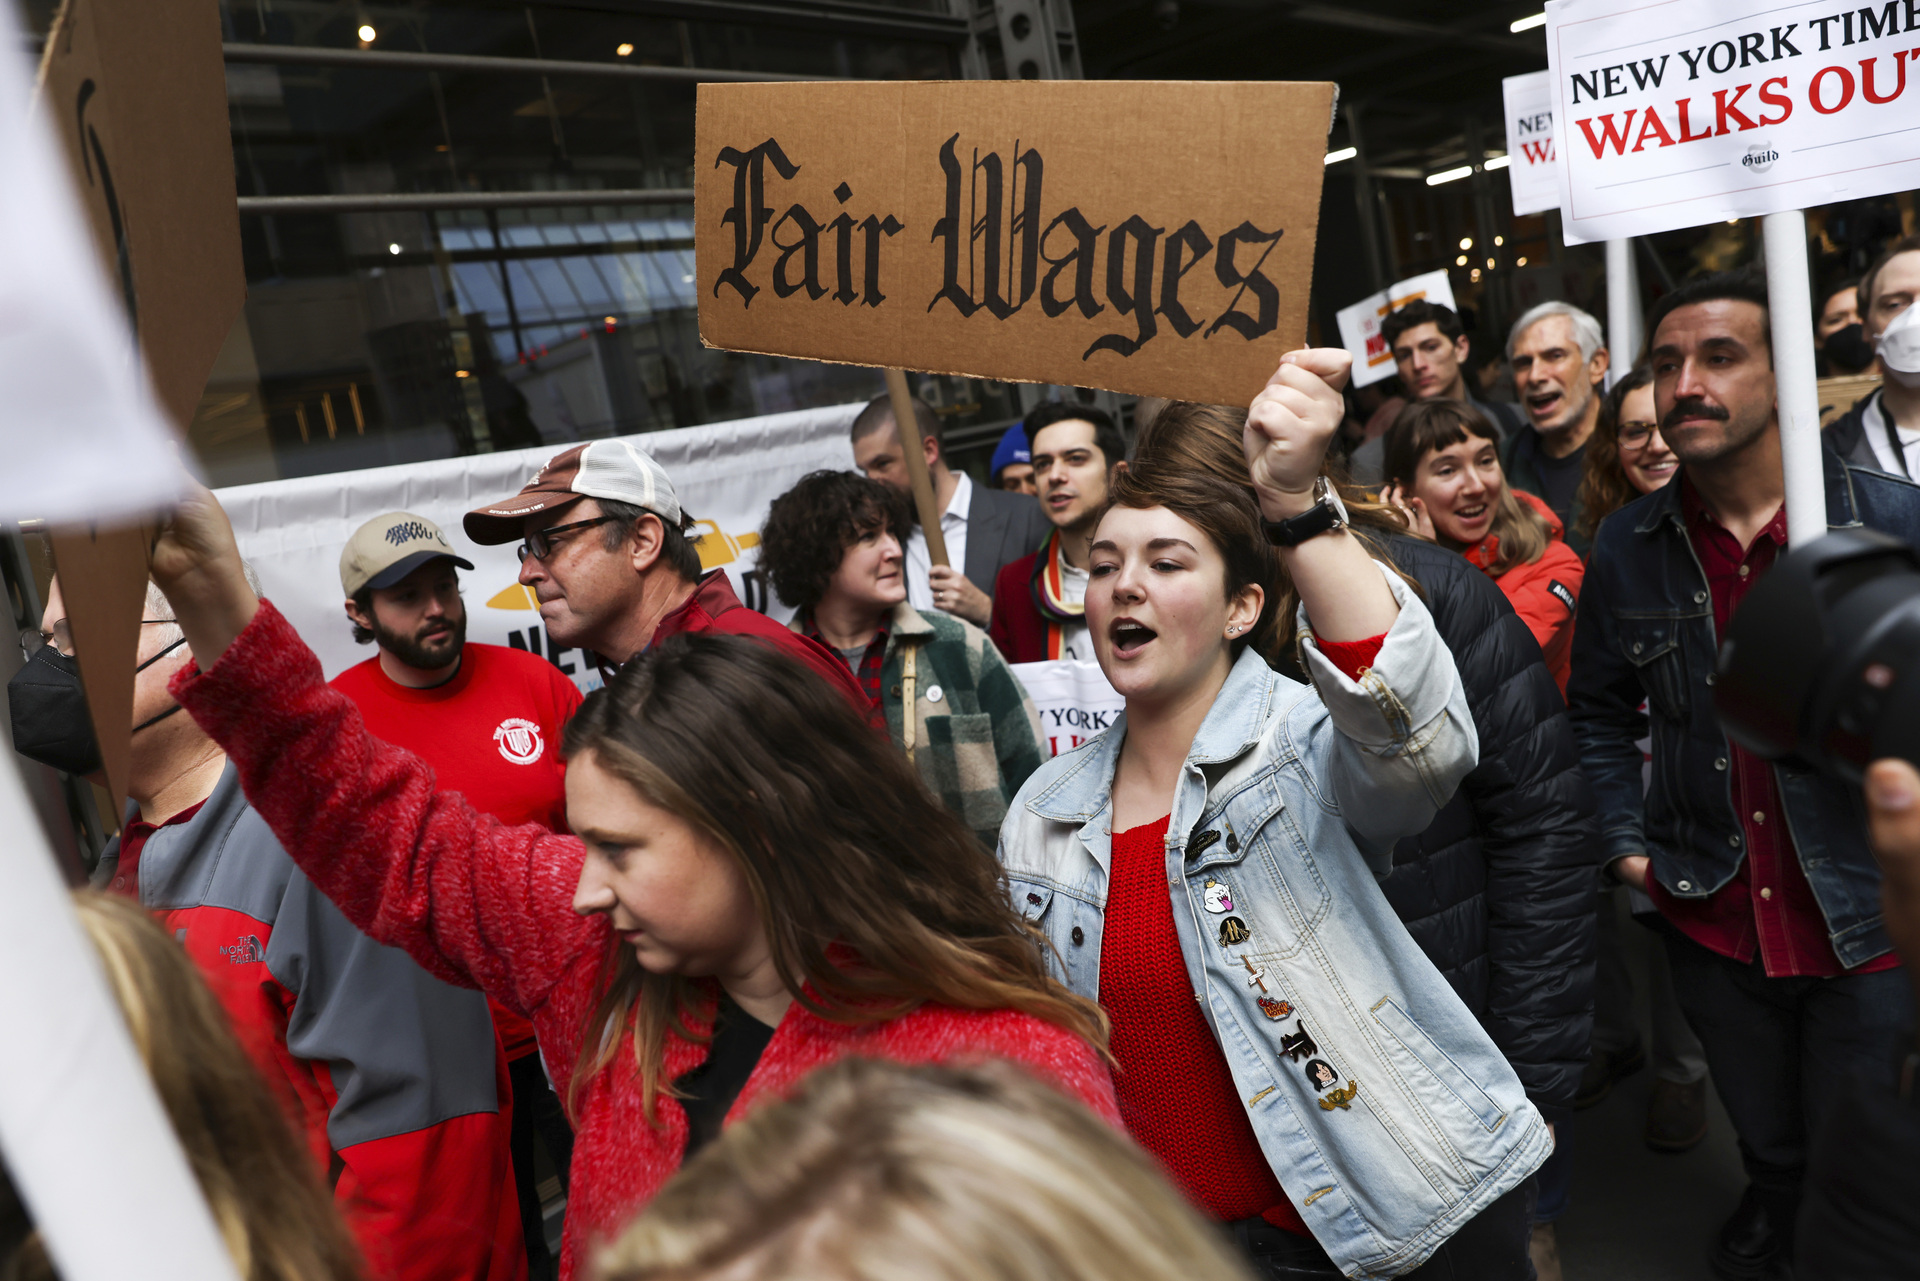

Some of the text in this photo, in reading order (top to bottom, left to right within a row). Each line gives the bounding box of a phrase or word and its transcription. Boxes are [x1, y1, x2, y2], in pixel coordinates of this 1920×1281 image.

[1570, 54, 1671, 104] NEW
[1678, 23, 1803, 81] YORK
[1575, 47, 1920, 160] WALKS OU
[1517, 110, 1553, 135] NE
[1741, 150, 1779, 167] Guild
[713, 132, 1284, 361] Fair Wages
[1050, 707, 1111, 730] YORK
[219, 945, 251, 955] NORTH
[237, 935, 251, 947] THE
[230, 953, 250, 965] FACE
